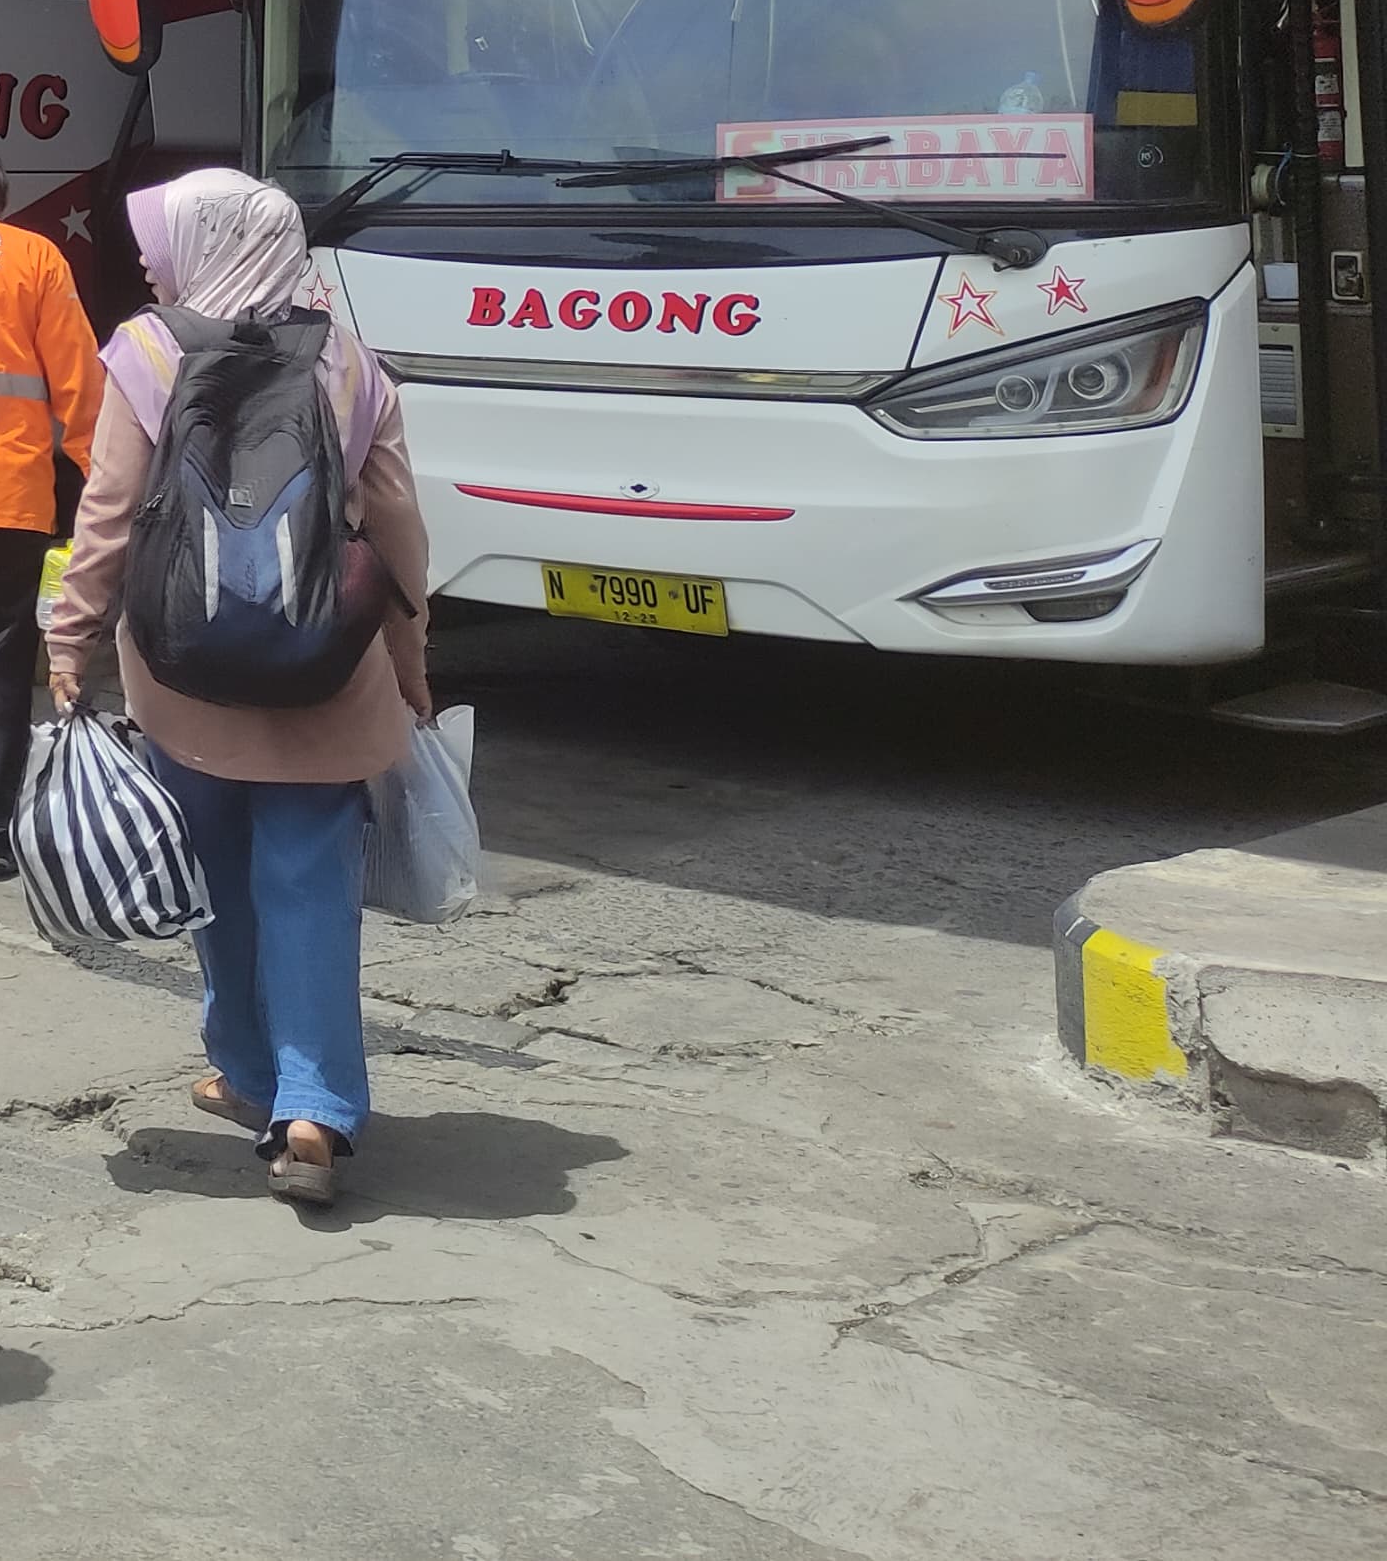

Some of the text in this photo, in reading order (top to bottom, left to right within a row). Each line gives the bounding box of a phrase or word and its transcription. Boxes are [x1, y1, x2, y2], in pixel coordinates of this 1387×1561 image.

[732, 128, 1082, 197] SURABAYA
[466, 285, 763, 338] BAGONG
[547, 569, 714, 615] N 7990 UF
